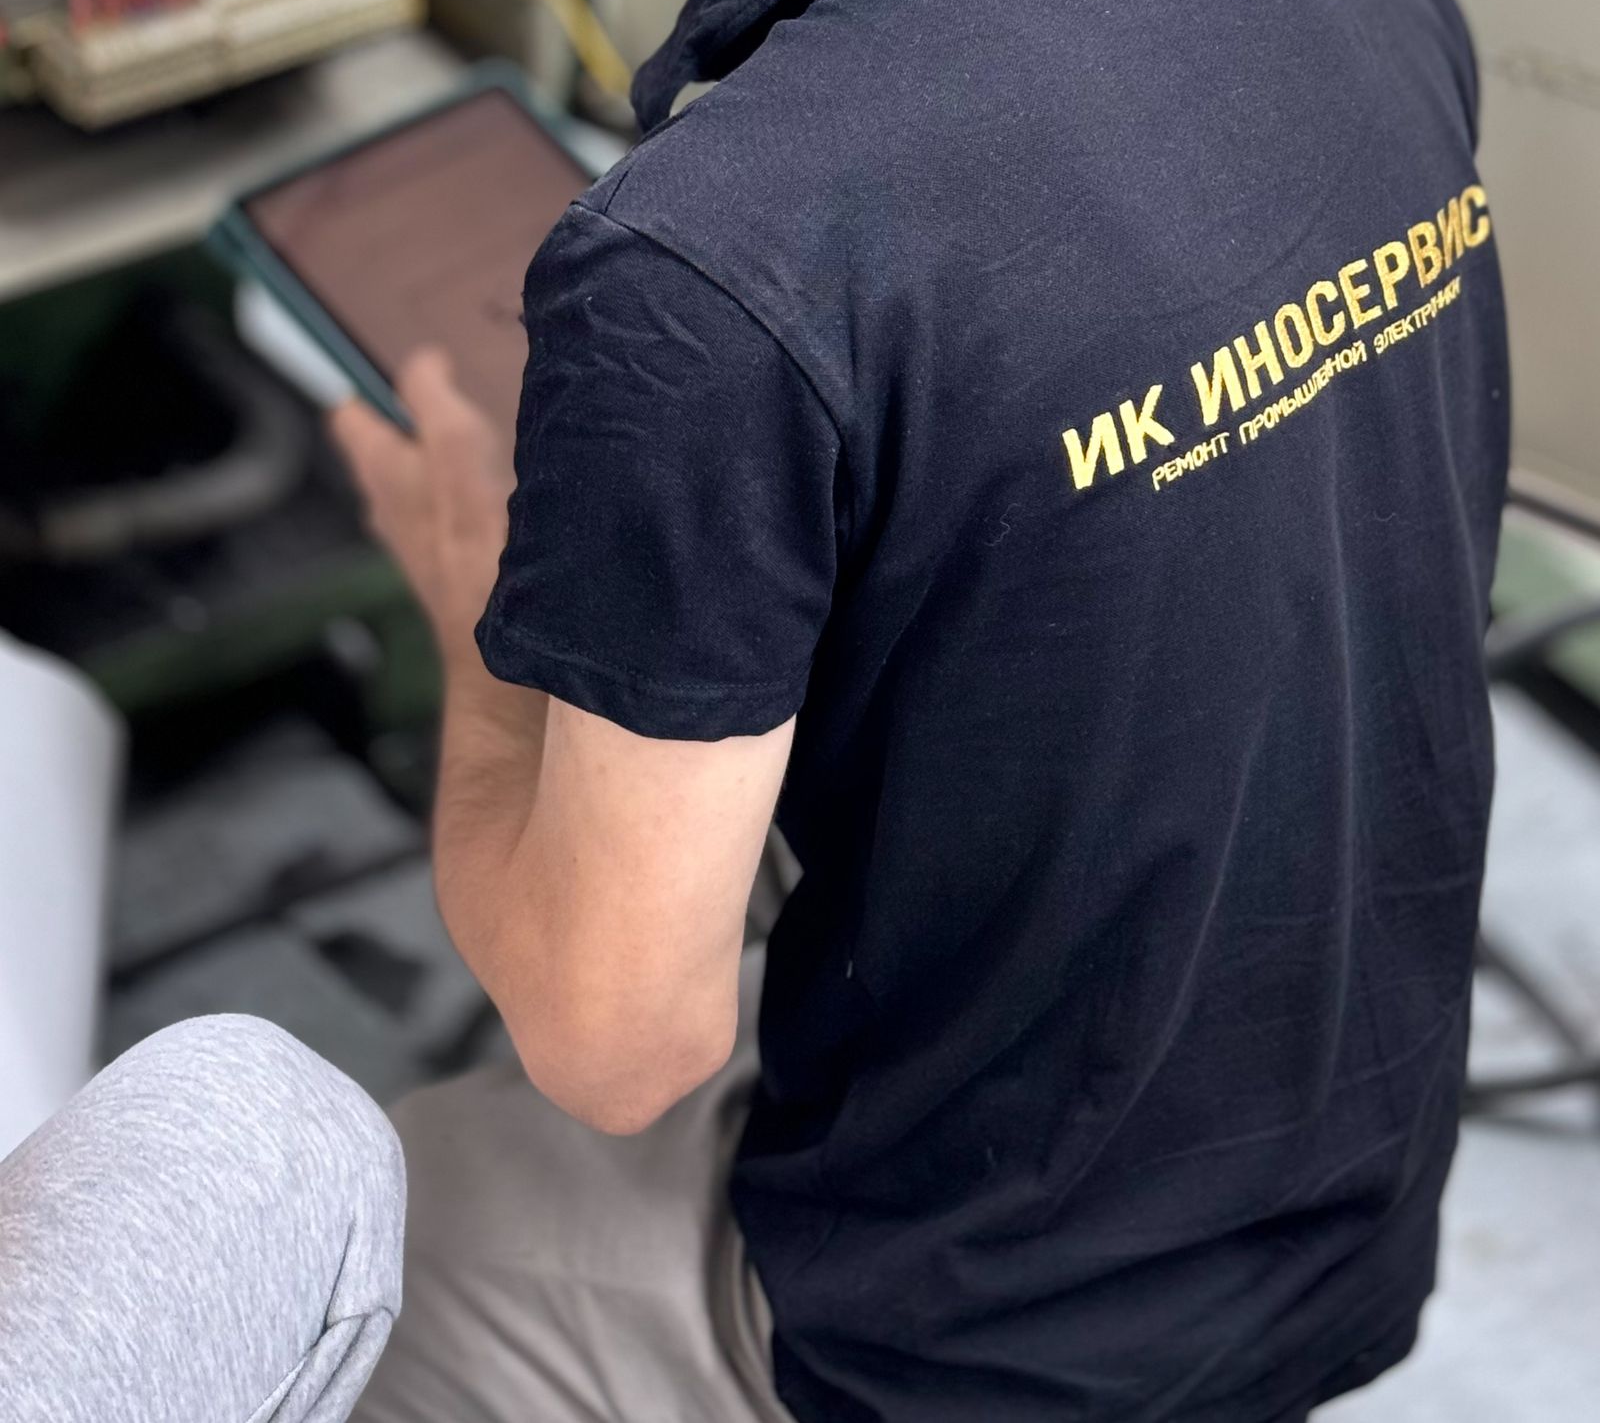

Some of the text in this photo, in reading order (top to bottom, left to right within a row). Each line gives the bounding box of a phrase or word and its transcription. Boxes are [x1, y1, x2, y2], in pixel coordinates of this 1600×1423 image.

[1062, 185, 1492, 490] ИК ИНОСЕРВИС
[1151, 432, 1230, 491] РЕМОНТ
